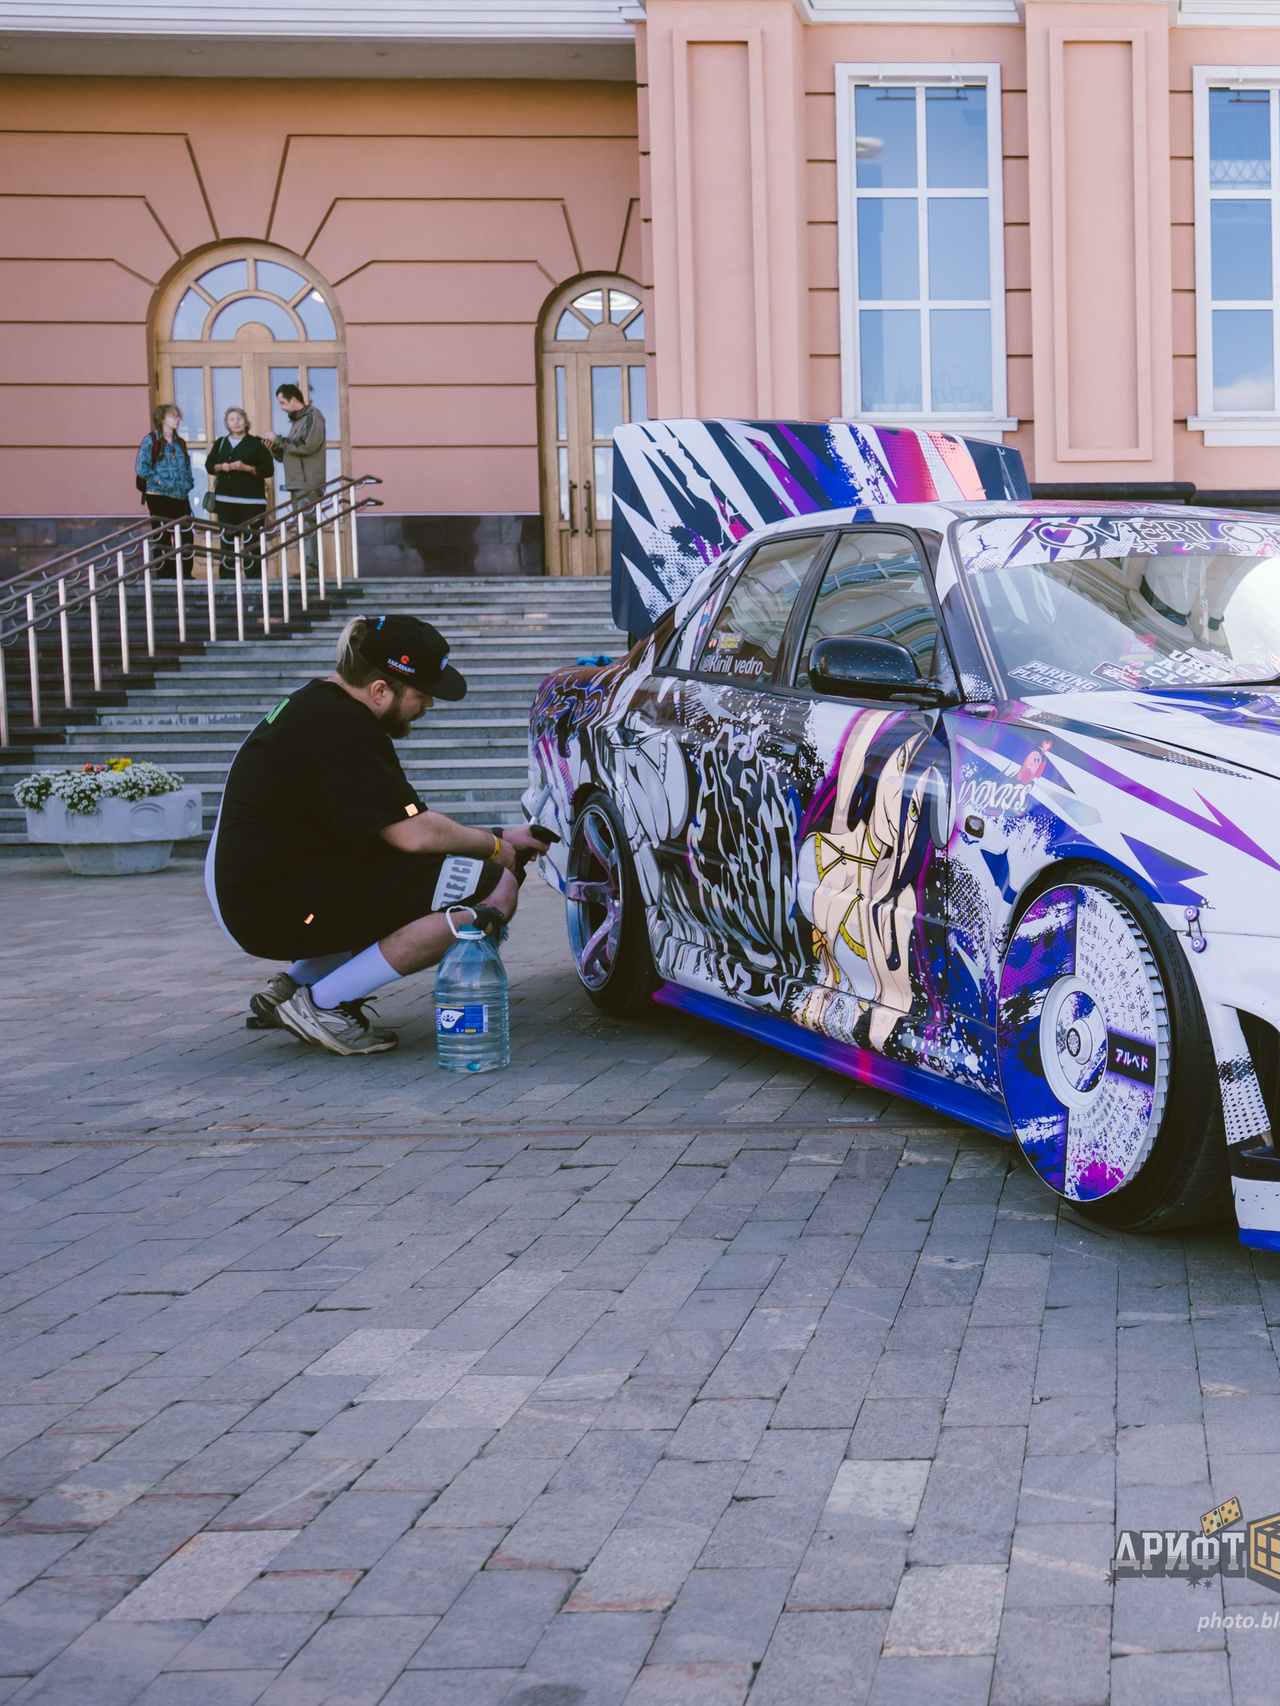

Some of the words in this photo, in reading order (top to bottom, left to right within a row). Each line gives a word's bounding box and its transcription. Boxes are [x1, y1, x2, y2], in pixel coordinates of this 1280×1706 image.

[703, 655, 764, 677] @Kirill_vedro
[1012, 668, 1059, 687] PLACE
[1024, 661, 1098, 690] PARKING
[1115, 1048, 1149, 1073] アルベド
